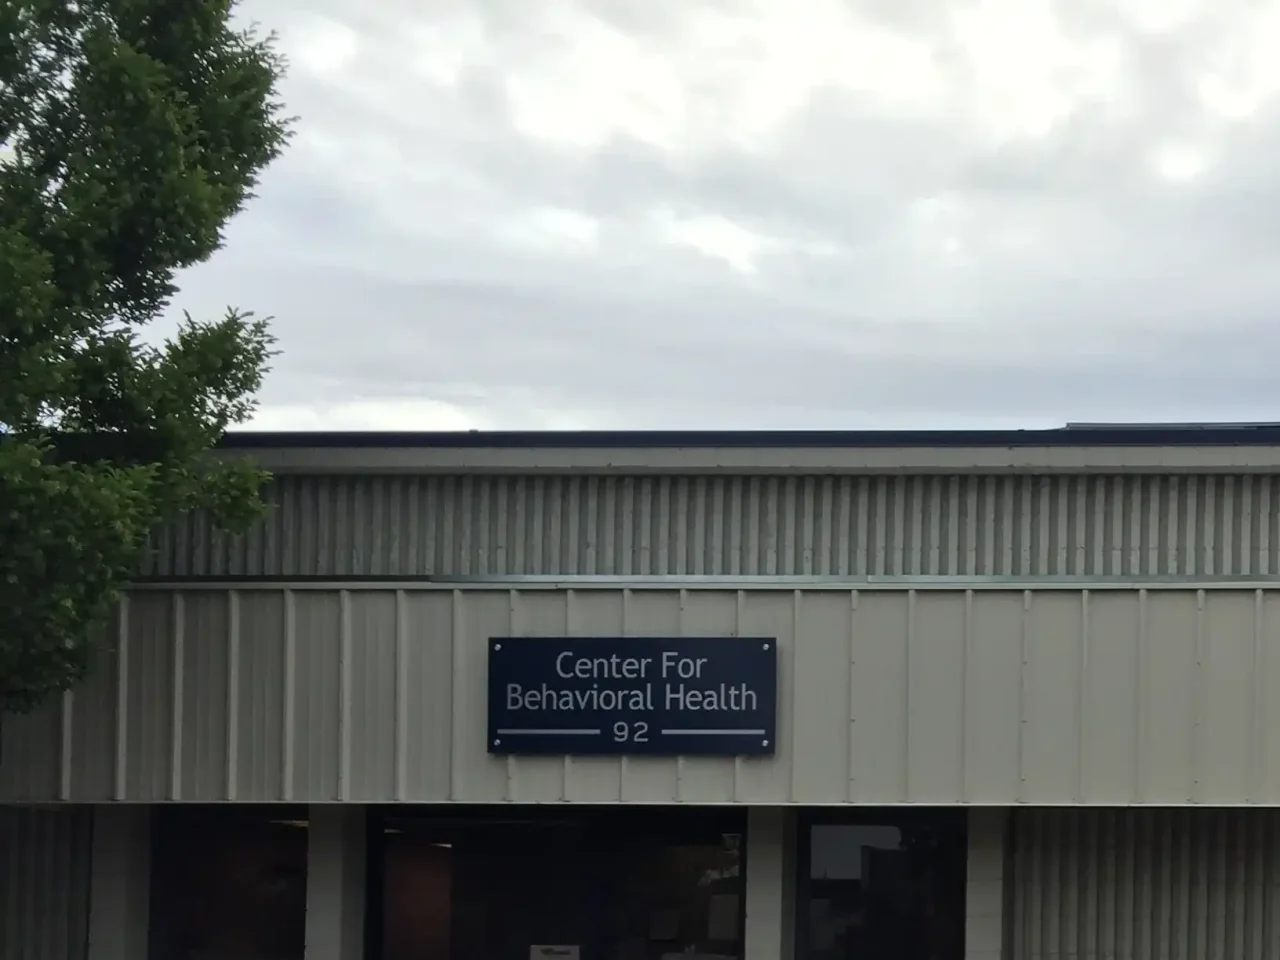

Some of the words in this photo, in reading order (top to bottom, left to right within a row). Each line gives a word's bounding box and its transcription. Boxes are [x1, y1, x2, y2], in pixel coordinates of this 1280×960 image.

[556, 651, 653, 679] Center
[662, 651, 708, 679] For
[507, 683, 654, 711] Behavioral
[665, 683, 757, 711] Health
[613, 721, 649, 742] 92
